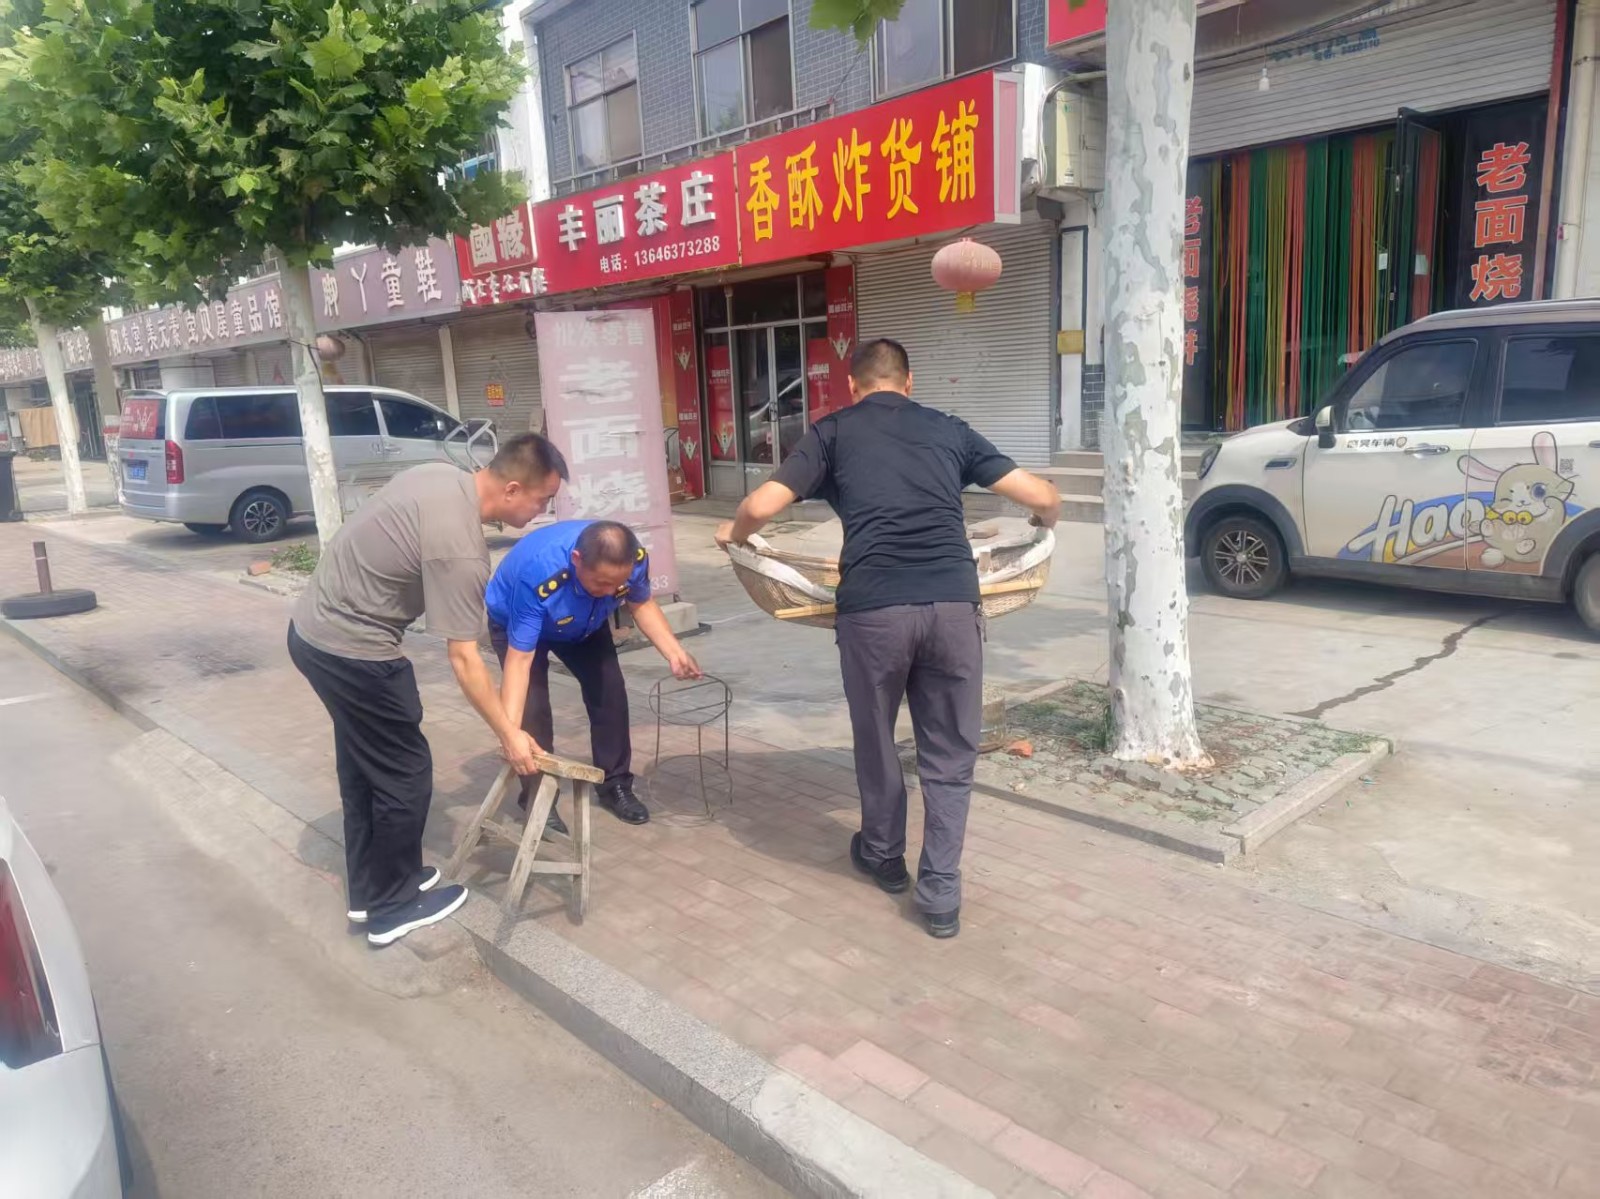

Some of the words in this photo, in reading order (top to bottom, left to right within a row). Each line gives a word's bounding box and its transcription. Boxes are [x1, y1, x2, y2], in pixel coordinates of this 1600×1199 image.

[557, 171, 717, 251] 丰丽茶庄
[745, 98, 980, 243] 香酥炸货铺
[1469, 142, 1532, 302] 老面烧
[322, 251, 443, 317] 脚丫童鞋
